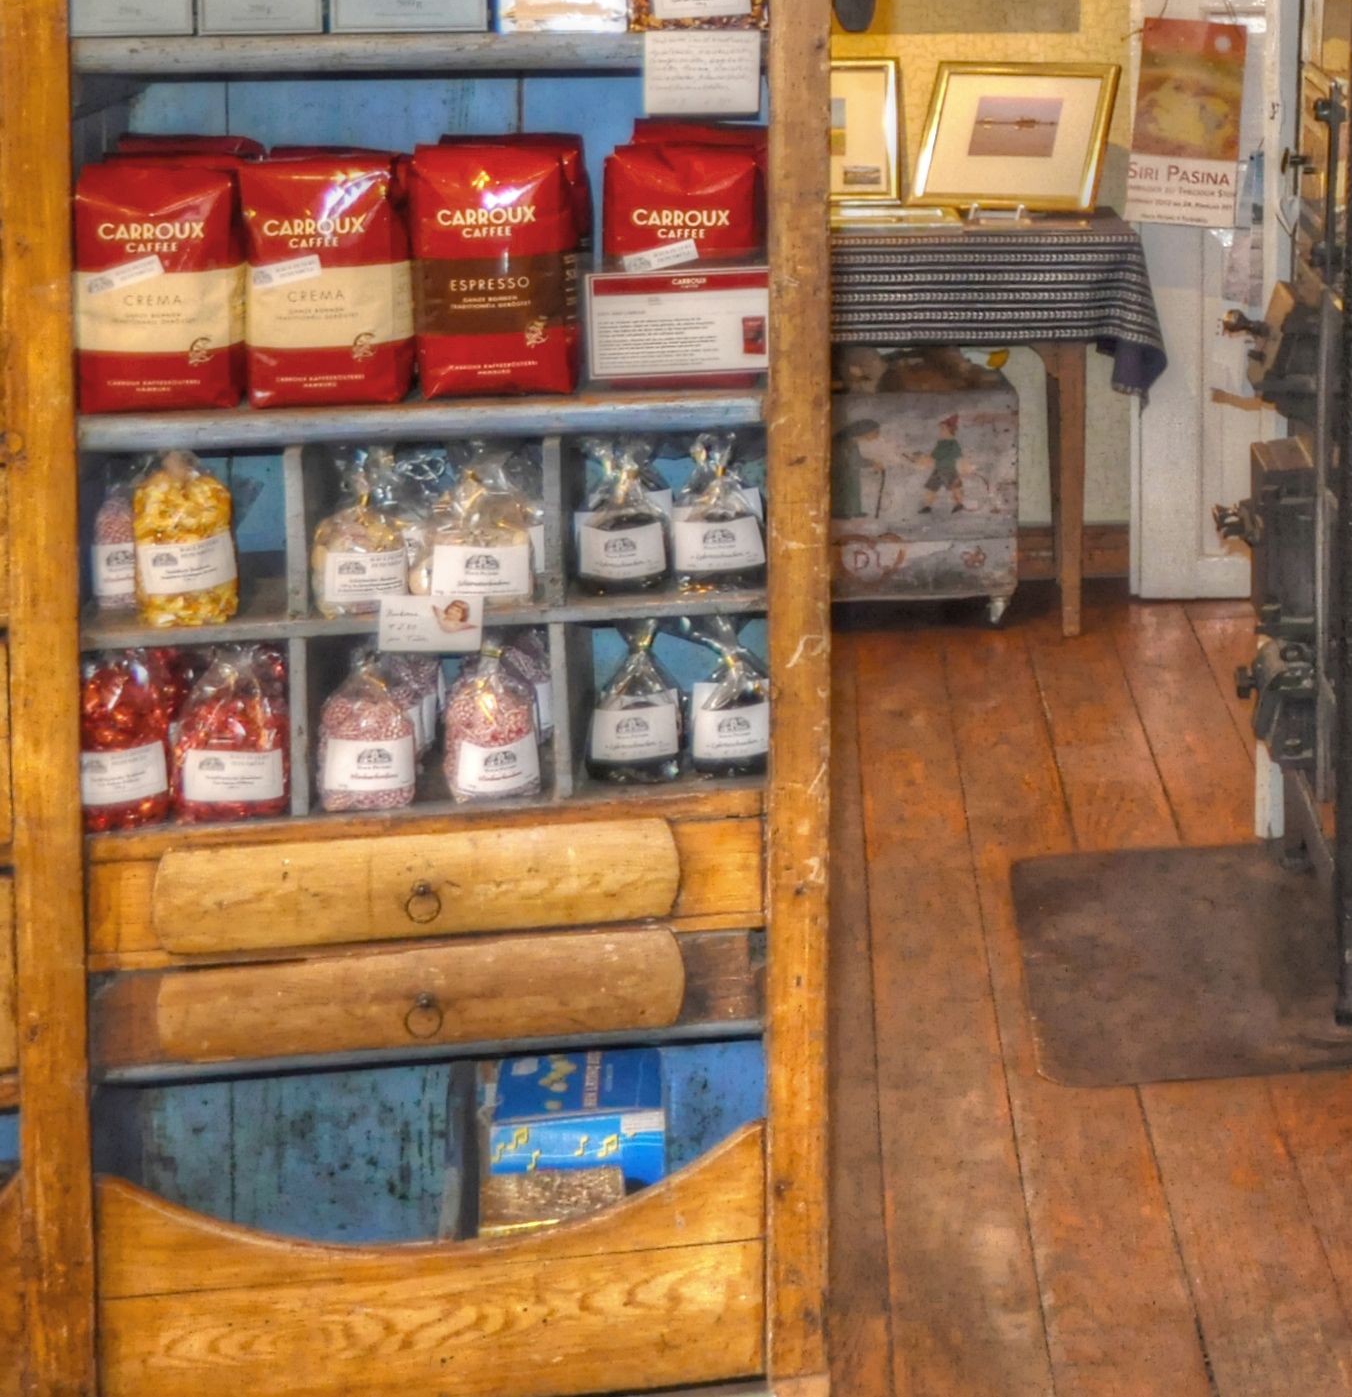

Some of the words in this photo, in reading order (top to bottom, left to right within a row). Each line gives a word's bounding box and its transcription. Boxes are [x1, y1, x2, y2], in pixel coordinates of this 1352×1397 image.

[1128, 161, 1159, 181] SIRI
[1167, 165, 1230, 185] PASINA
[437, 206, 537, 226] CARROUX
[632, 209, 730, 227] CARROUX
[98, 221, 205, 241] CARROUX
[262, 214, 368, 236] CARROUX
[462, 226, 512, 239] CAFFEE
[657, 228, 706, 240] CAFFEE
[126, 242, 179, 254] CAFFEE
[288, 236, 340, 249] CAFFEE
[450, 276, 530, 292] ESPRESSO
[123, 294, 183, 307] CREMA
[286, 289, 346, 303] CREMA
